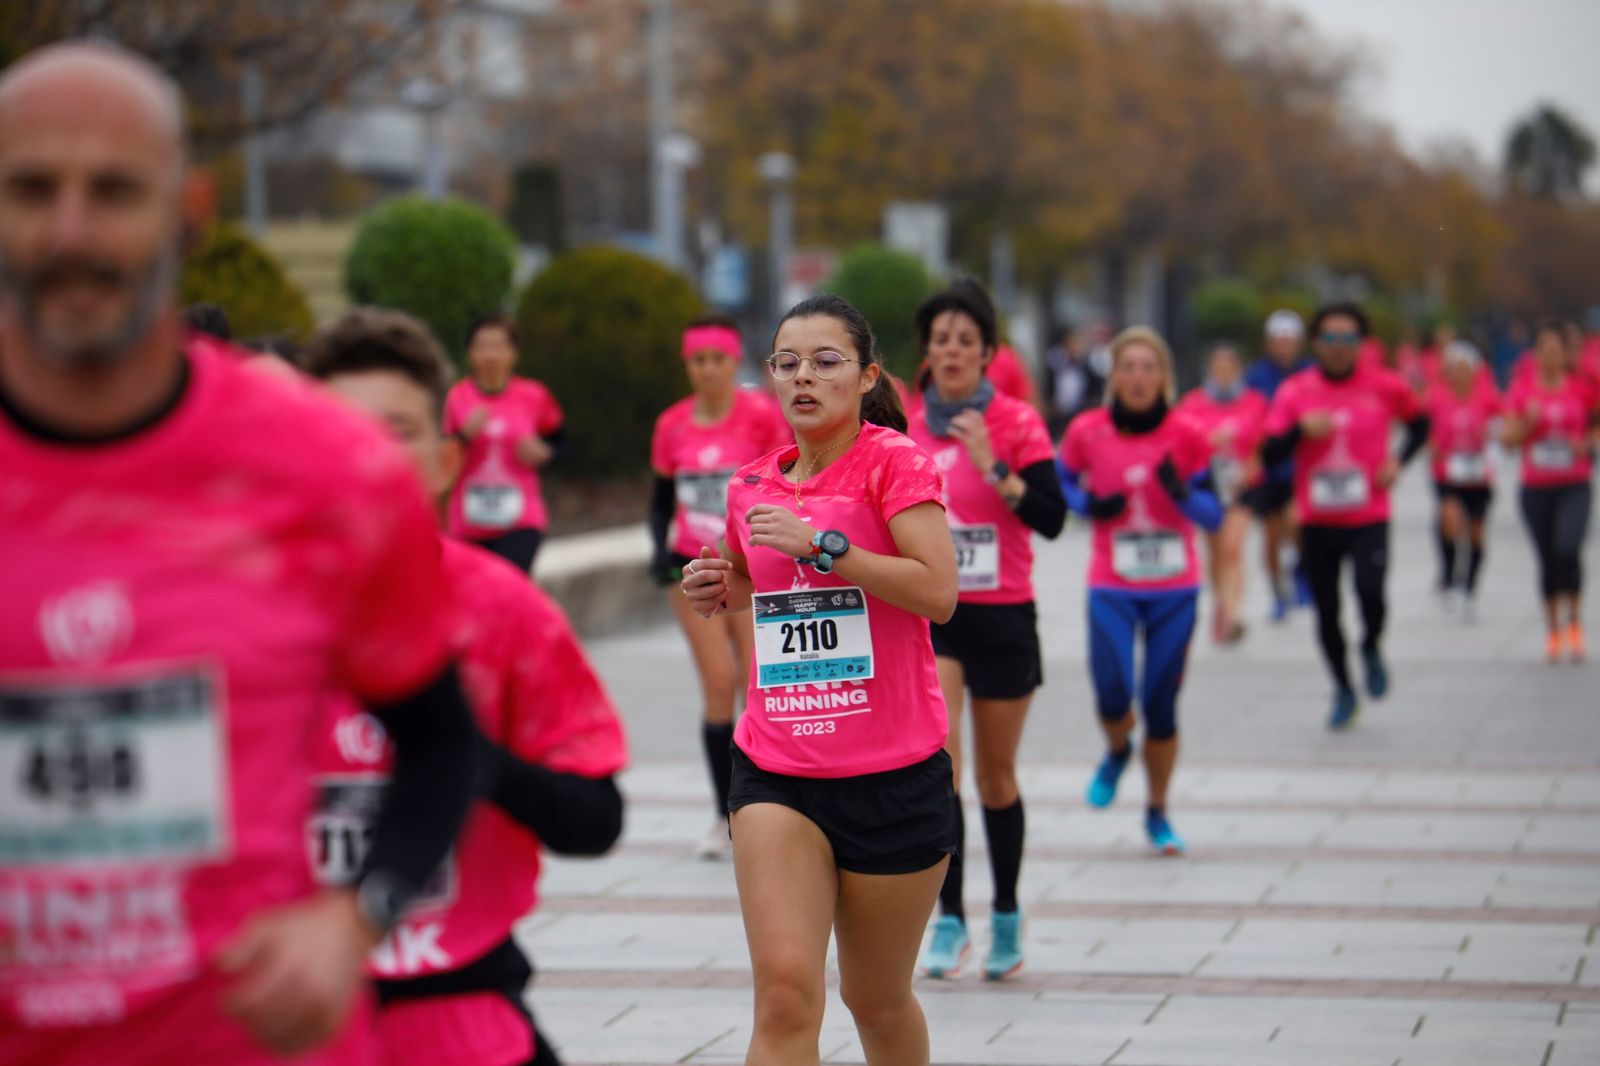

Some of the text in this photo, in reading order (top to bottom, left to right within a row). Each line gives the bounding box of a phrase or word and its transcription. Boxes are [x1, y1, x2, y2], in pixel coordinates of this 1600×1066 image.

[781, 619, 838, 654] 2110
[765, 689, 868, 713] RUNNING
[792, 721, 836, 736] 2023
